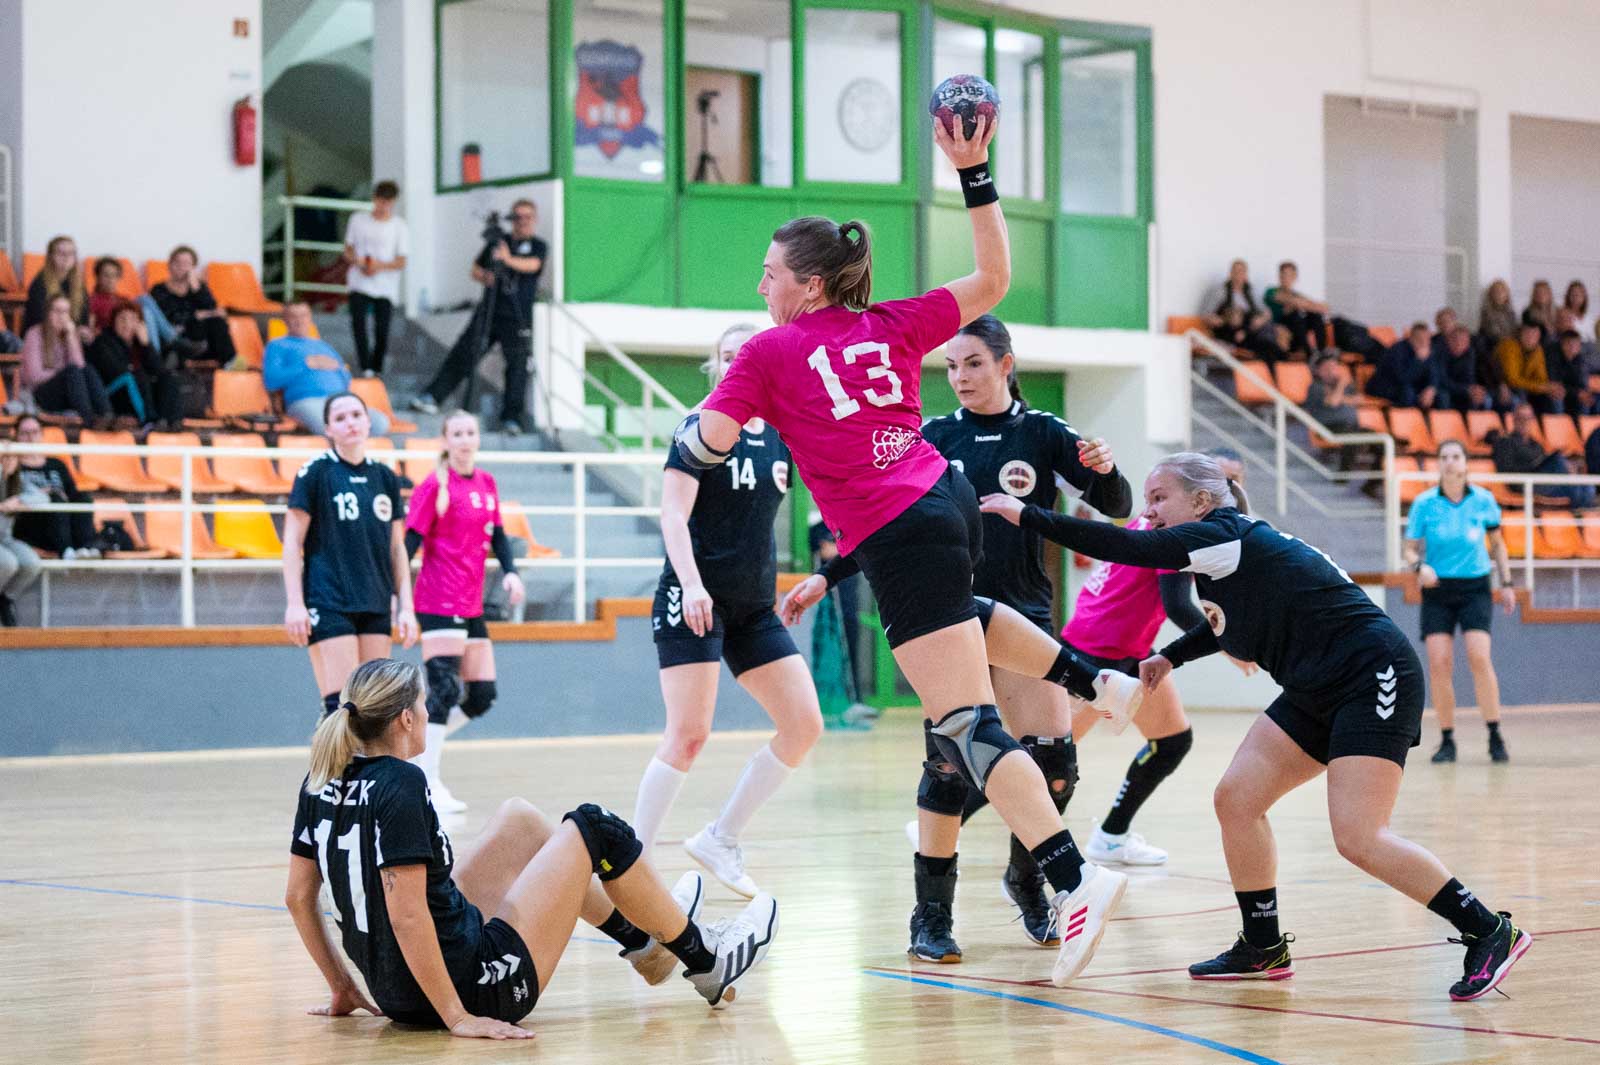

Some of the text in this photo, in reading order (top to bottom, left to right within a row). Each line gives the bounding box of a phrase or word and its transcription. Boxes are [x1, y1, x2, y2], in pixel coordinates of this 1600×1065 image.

[941, 86, 984, 101] SELECT
[807, 341, 904, 421] 13
[726, 457, 757, 490] 14
[333, 492, 359, 520] 13
[318, 778, 376, 806] ESZK
[313, 819, 369, 933] 11
